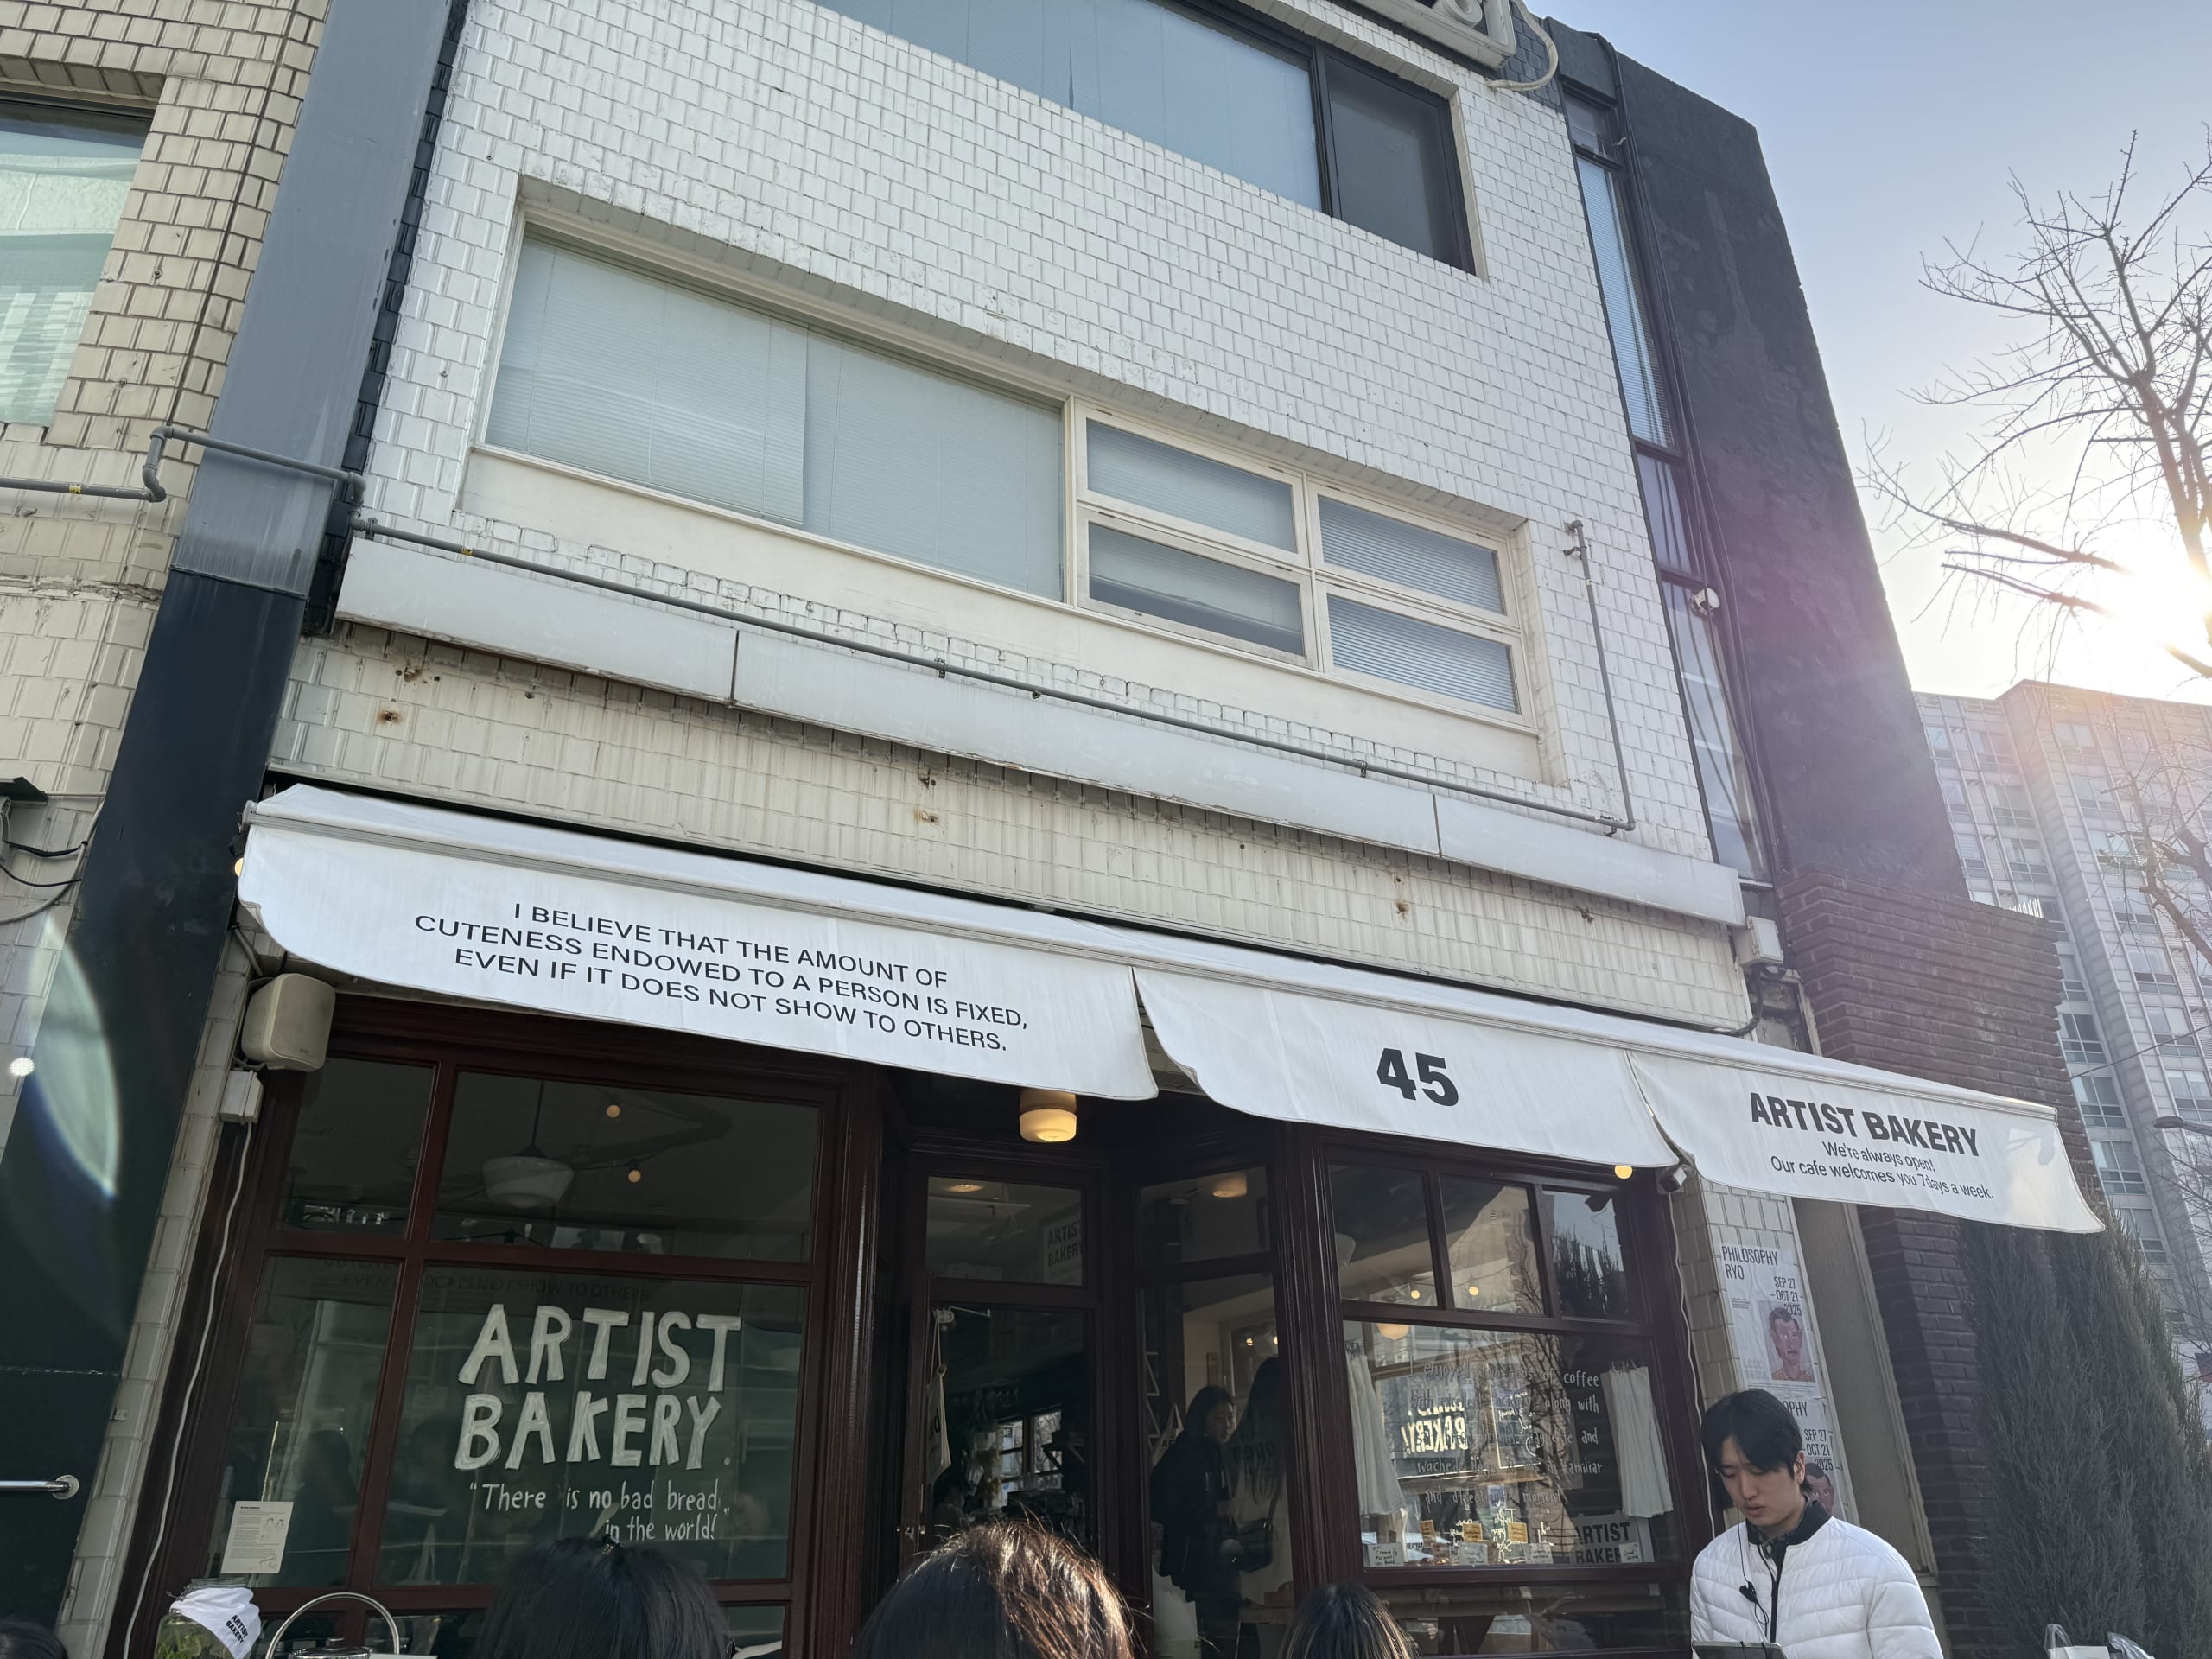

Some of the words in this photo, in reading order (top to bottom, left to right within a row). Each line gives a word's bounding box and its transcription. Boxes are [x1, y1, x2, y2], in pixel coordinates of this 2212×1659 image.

[515, 903, 520, 918] I
[532, 906, 651, 943] BELIEVE
[658, 929, 729, 954] THAT
[736, 941, 789, 963] THE
[798, 950, 908, 982] AMOUNT
[916, 969, 947, 988] OF
[416, 916, 582, 954] CUTENESS
[593, 943, 740, 981] ENDOWED
[748, 969, 784, 988] TO
[793, 975, 810, 991] A
[819, 977, 918, 1010] PERSON
[927, 996, 948, 1014] IS
[956, 1001, 1027, 1029] FIXED,
[455, 949, 538, 976] EVEN
[551, 962, 576, 979] IF
[588, 967, 612, 984] IT
[622, 973, 699, 1001] DOES
[710, 989, 766, 1012] NOT
[776, 998, 856, 1024] SHOW
[863, 1010, 895, 1033] TO
[904, 1020, 1006, 1051] OTHERS.
[1376, 1048, 1459, 1106] 45
[1751, 1092, 1857, 1139] ARTIST
[1862, 1111, 1979, 1157] BAKERY
[1822, 1141, 1859, 1160] We're
[1861, 1147, 1903, 1166] always
[1904, 1156, 1936, 1172] open!
[1771, 1156, 1795, 1173] Our
[1799, 1160, 1827, 1176] cafe
[1829, 1163, 1895, 1182] welcomes
[1896, 1173, 1917, 1186] you
[1917, 1173, 1949, 1195] 7days
[1951, 1184, 1959, 1194] a
[1960, 1184, 1994, 1199] week.
[1722, 1246, 1778, 1265] PHILOSOPHY
[1726, 1264, 1745, 1280] RYO
[1774, 1276, 1787, 1288] SEP
[1788, 1279, 1796, 1289] 27
[1791, 1292, 1799, 1302] 21
[1784, 1304, 1802, 1316] 2025
[458, 1303, 741, 1392] ARTIST
[1563, 1370, 1599, 1387] coffee
[1578, 1394, 1599, 1414] with
[1581, 1427, 1599, 1445] and
[1804, 1428, 1817, 1441] SEP
[1819, 1429, 1827, 1442] 27
[1821, 1444, 1830, 1456] 21
[1815, 1458, 1833, 1471] 2025
[566, 1487, 580, 1509] is
[589, 1490, 612, 1509] no
[620, 1480, 653, 1510] bad
[626, 1513, 656, 1540] the
[664, 1512, 719, 1541] world!
[226, 1620, 244, 1644] BAKERY
[231, 1615, 248, 1638] ARTIST
